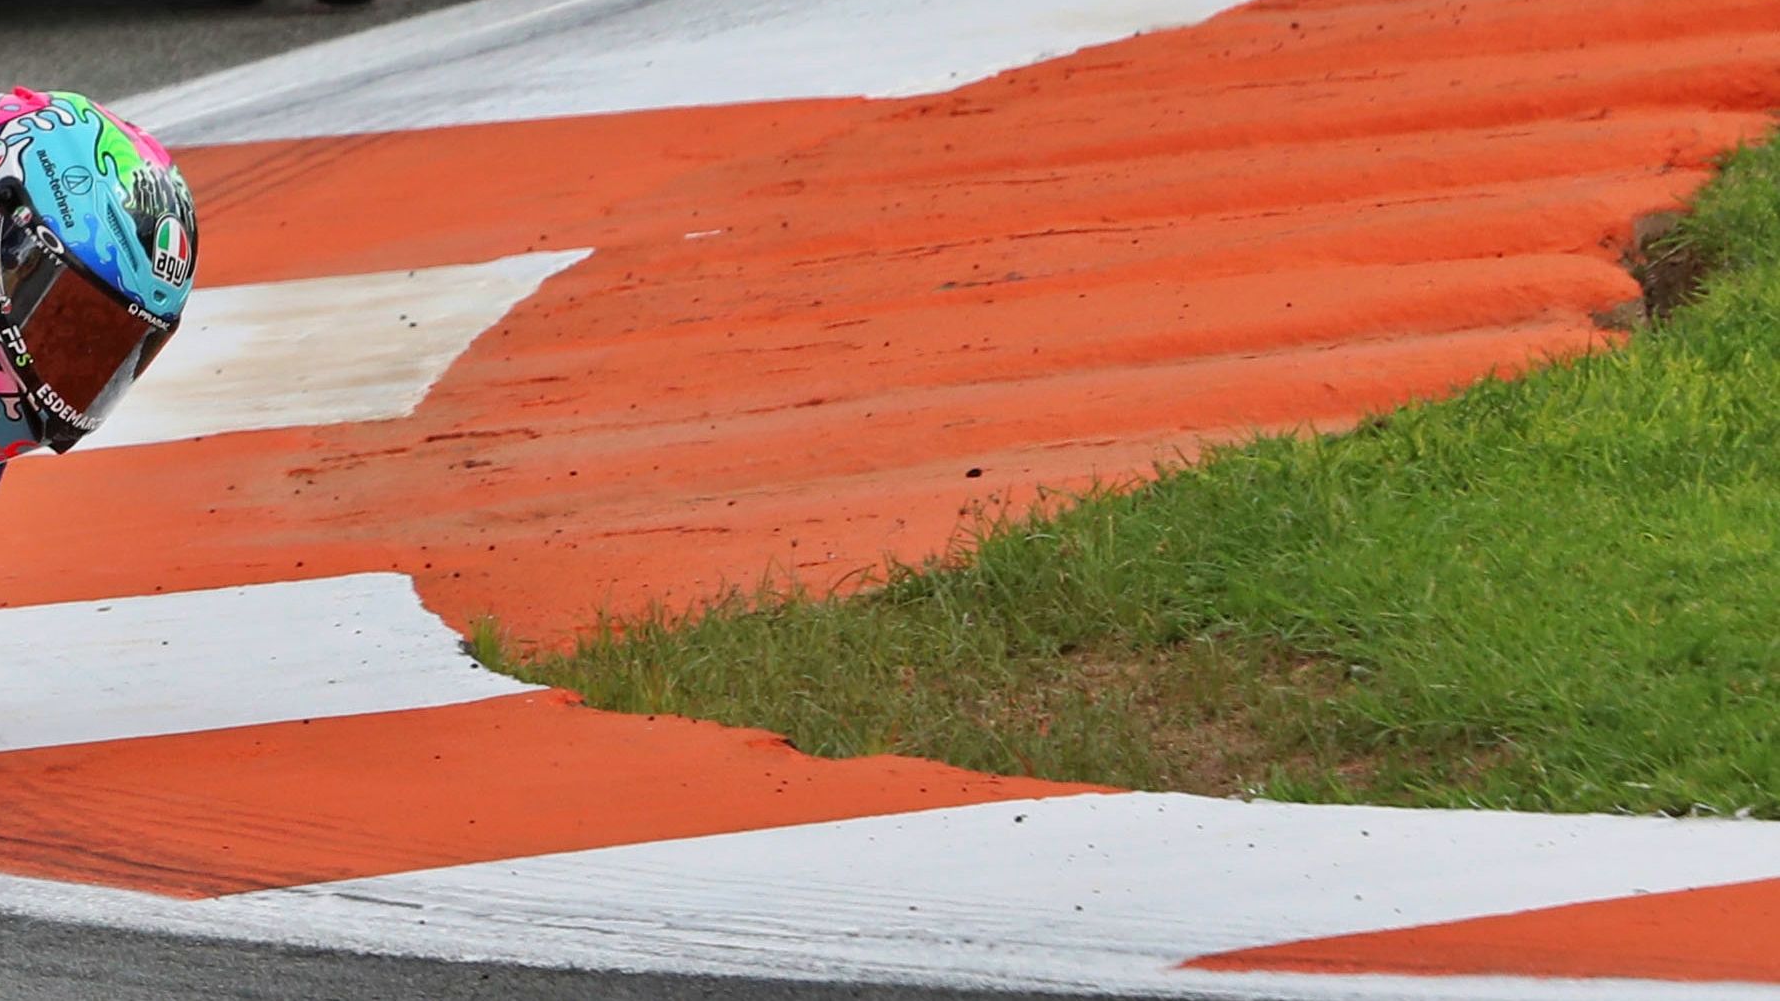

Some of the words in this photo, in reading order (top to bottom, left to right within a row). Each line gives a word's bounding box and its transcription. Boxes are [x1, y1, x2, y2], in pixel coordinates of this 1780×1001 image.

[35, 149, 75, 229] audio-technica
[154, 250, 186, 285] agv
[2, 326, 31, 368] FPS
